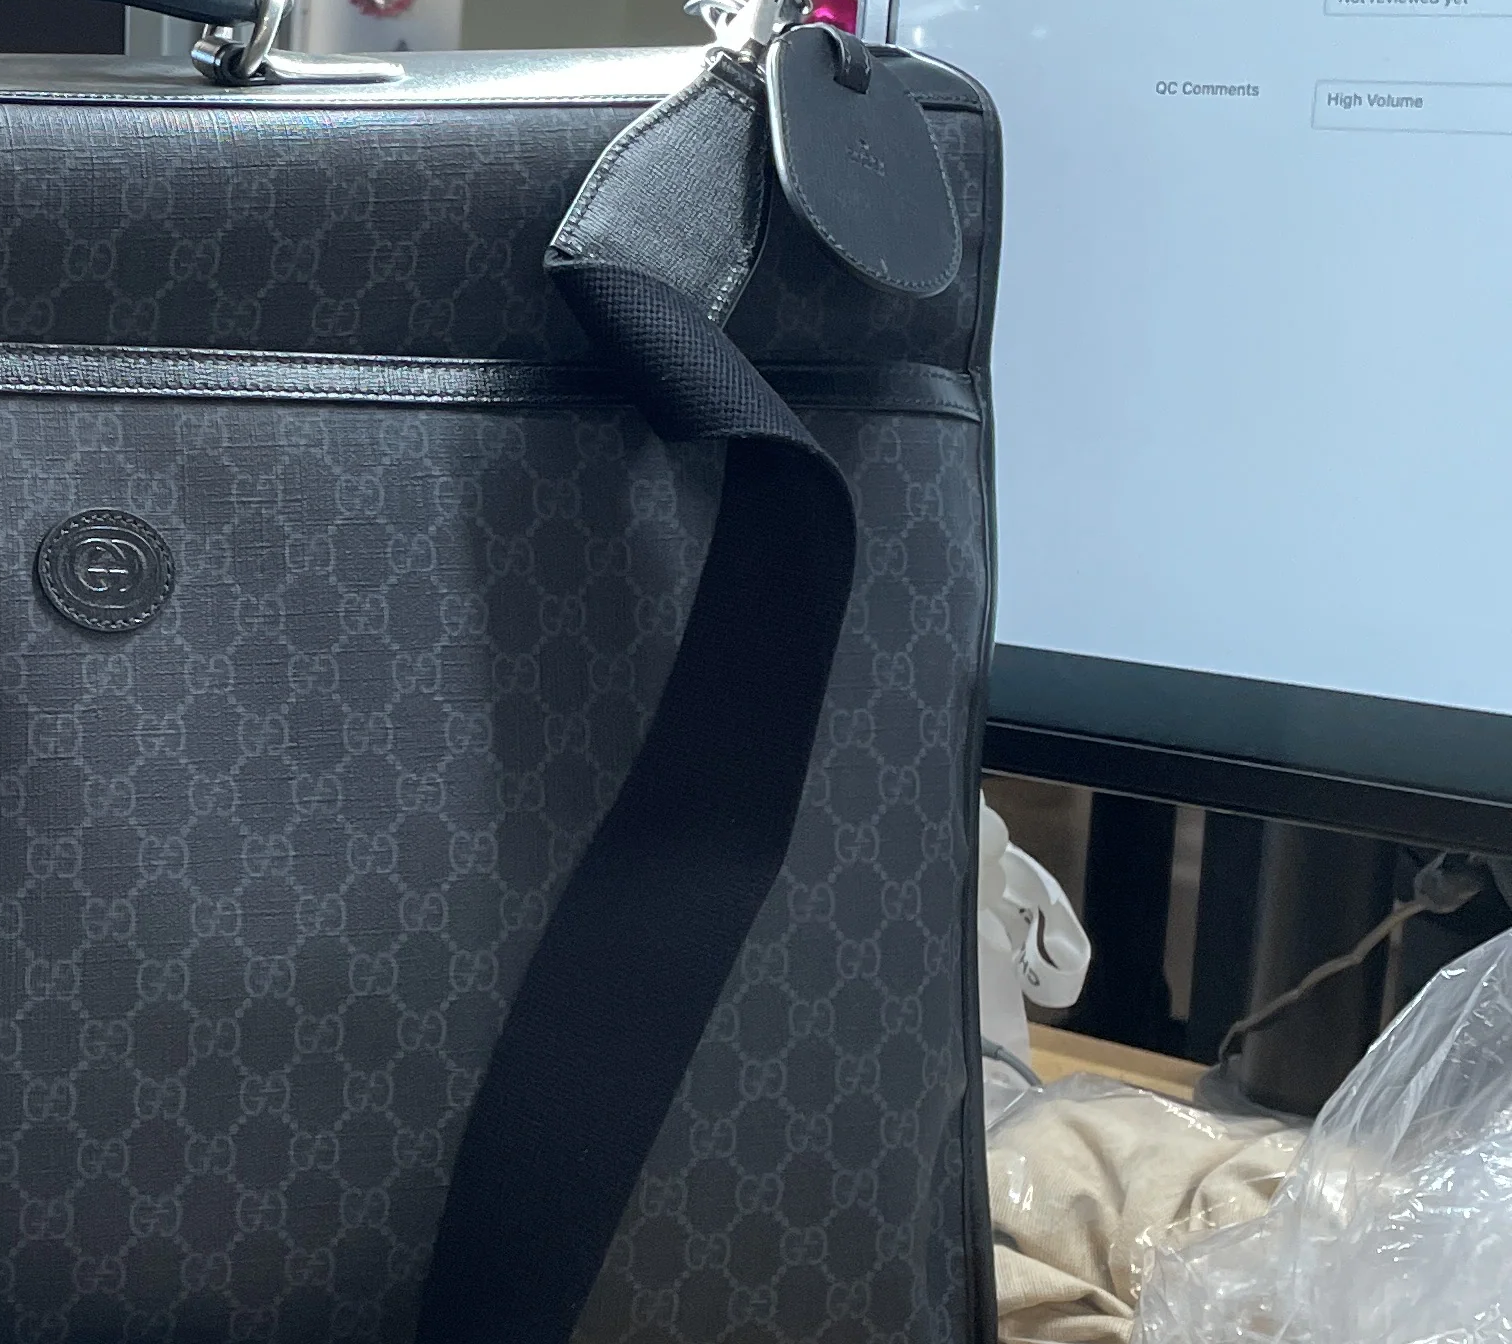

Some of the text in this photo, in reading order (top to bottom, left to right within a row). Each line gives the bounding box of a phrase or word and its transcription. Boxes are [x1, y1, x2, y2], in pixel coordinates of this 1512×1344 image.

[1155, 80, 1260, 97] QC Comments
[1326, 92, 1424, 109] High Volume
